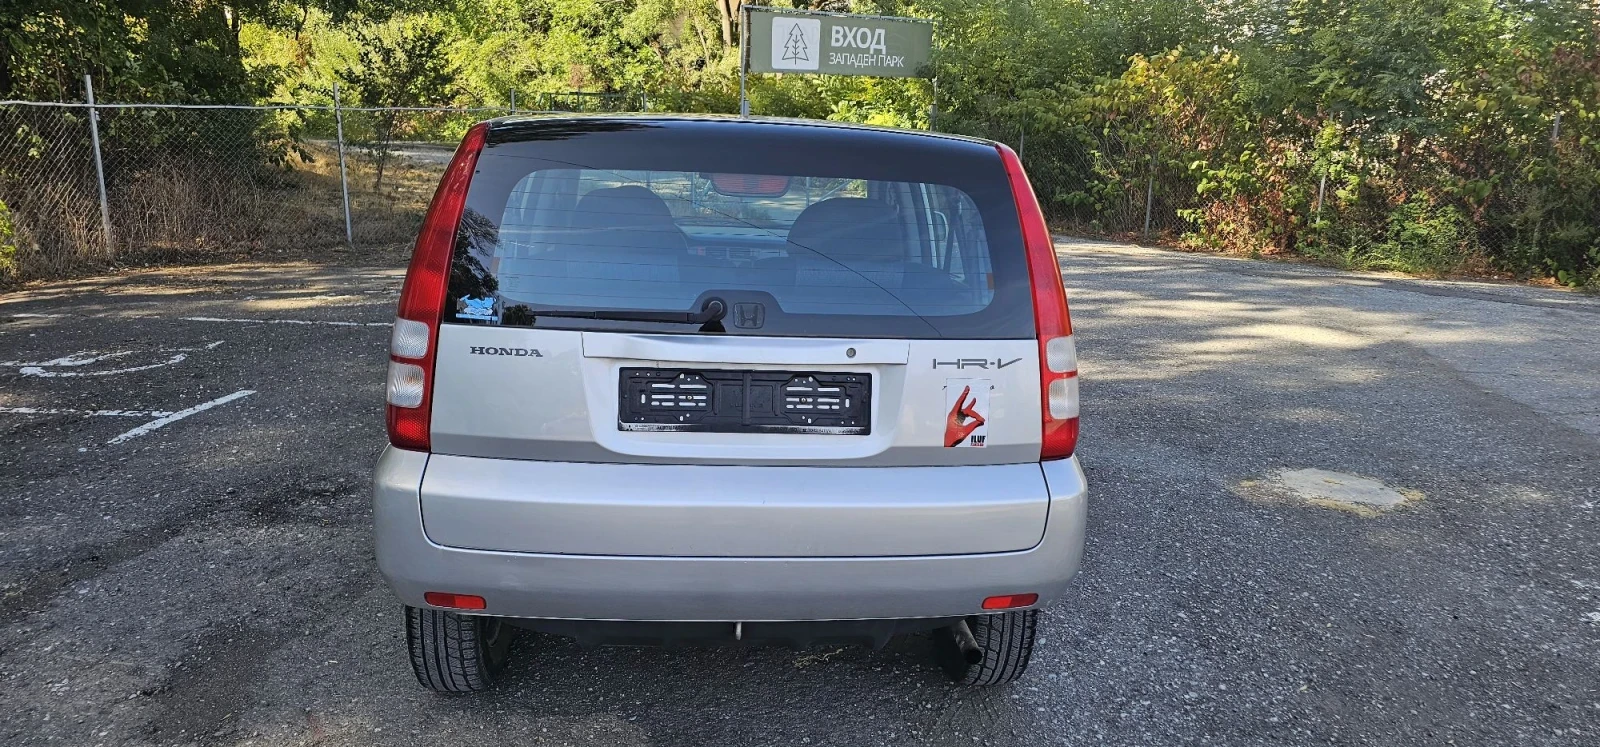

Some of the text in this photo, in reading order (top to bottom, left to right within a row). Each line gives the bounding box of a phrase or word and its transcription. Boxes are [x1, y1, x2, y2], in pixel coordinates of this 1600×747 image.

[830, 25, 887, 54] ВХОД
[828, 52, 904, 68] ЗАПАДЕН ПАРК
[469, 346, 543, 358] HONDA
